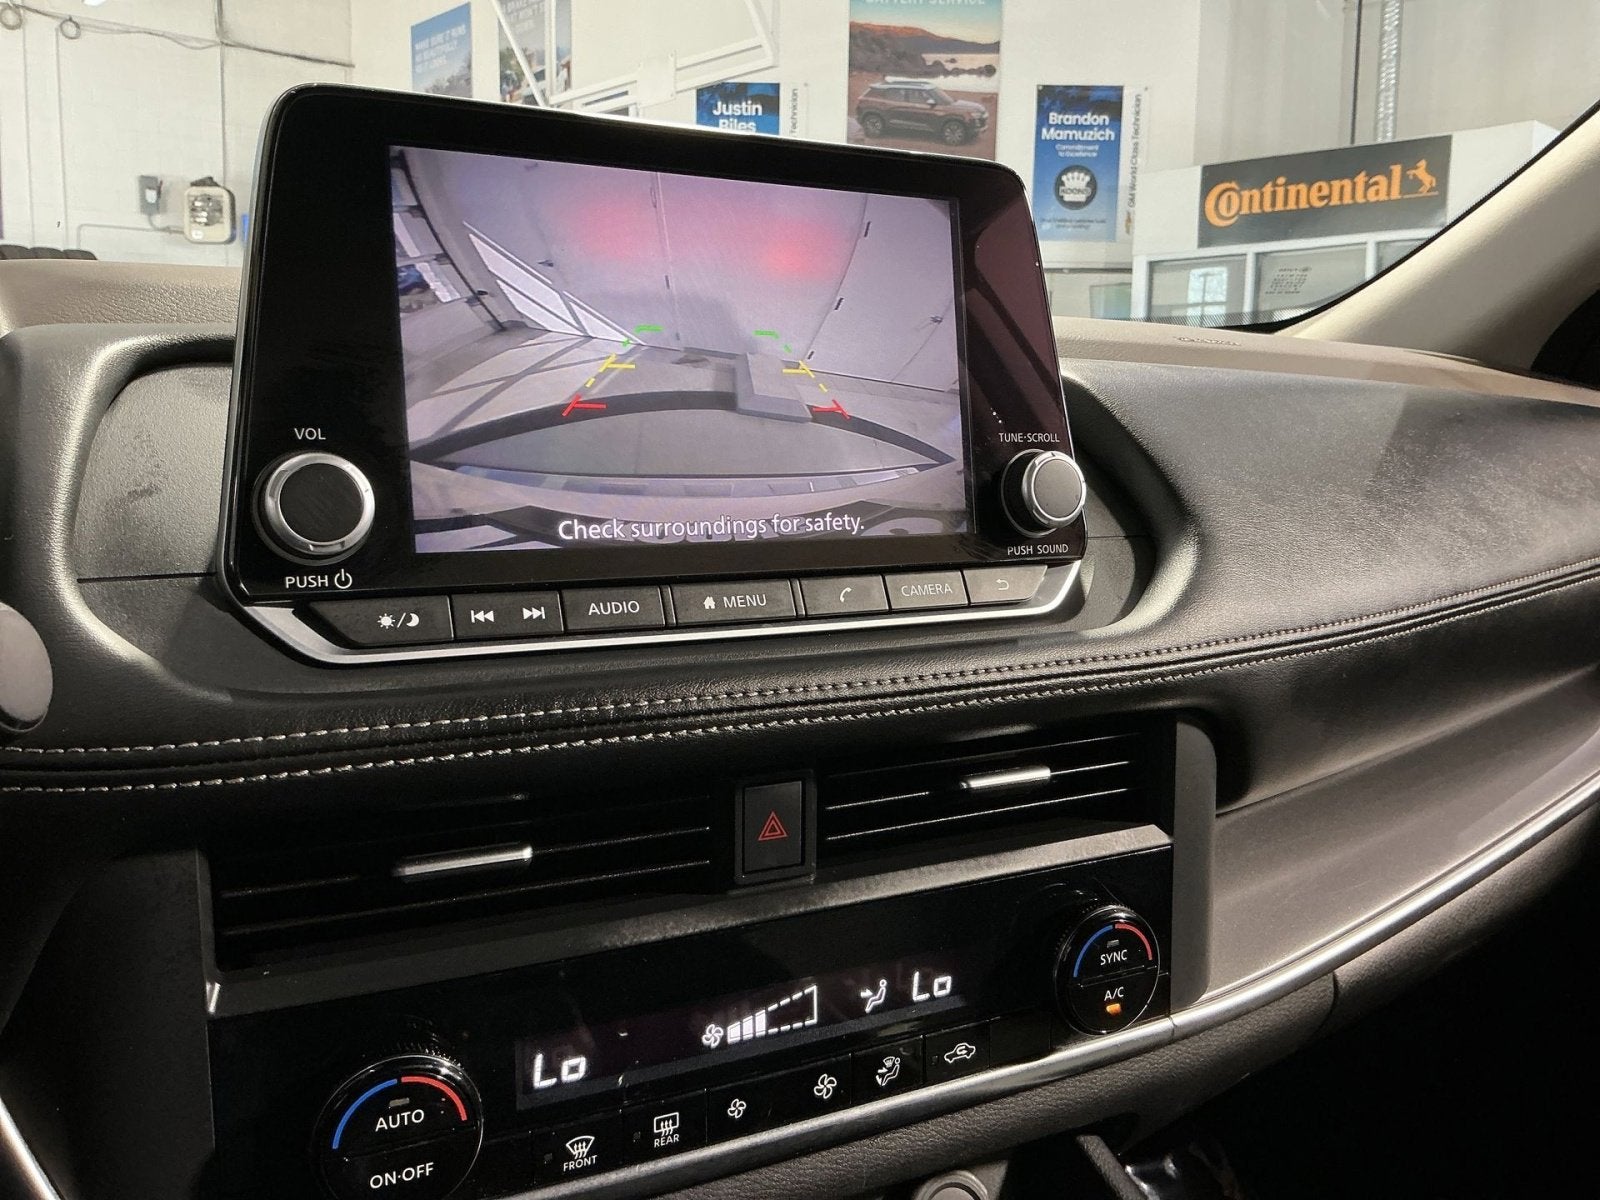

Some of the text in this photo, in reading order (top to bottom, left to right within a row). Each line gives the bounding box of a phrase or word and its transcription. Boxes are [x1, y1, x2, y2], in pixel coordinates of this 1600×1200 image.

[712, 100, 763, 116] Justin
[1048, 112, 1110, 126] Brandon
[1131, 94, 1142, 140] Technician
[1041, 127, 1116, 141] Mamuzich
[1204, 164, 1402, 227] Continental
[294, 427, 326, 441] VOL
[558, 512, 865, 541] Check surroundings for safety.
[1007, 543, 1069, 556] PUSH SOUND
[285, 575, 329, 589] PUSH
[901, 583, 953, 597] CAMERA
[588, 600, 640, 616] AUDIO
[723, 594, 767, 608] MENU
[1100, 949, 1128, 966] SYNC
[1104, 986, 1125, 1002] A/C
[374, 1108, 426, 1132] AUTO
[653, 1133, 680, 1149] REAR
[562, 1154, 598, 1172] FRONT
